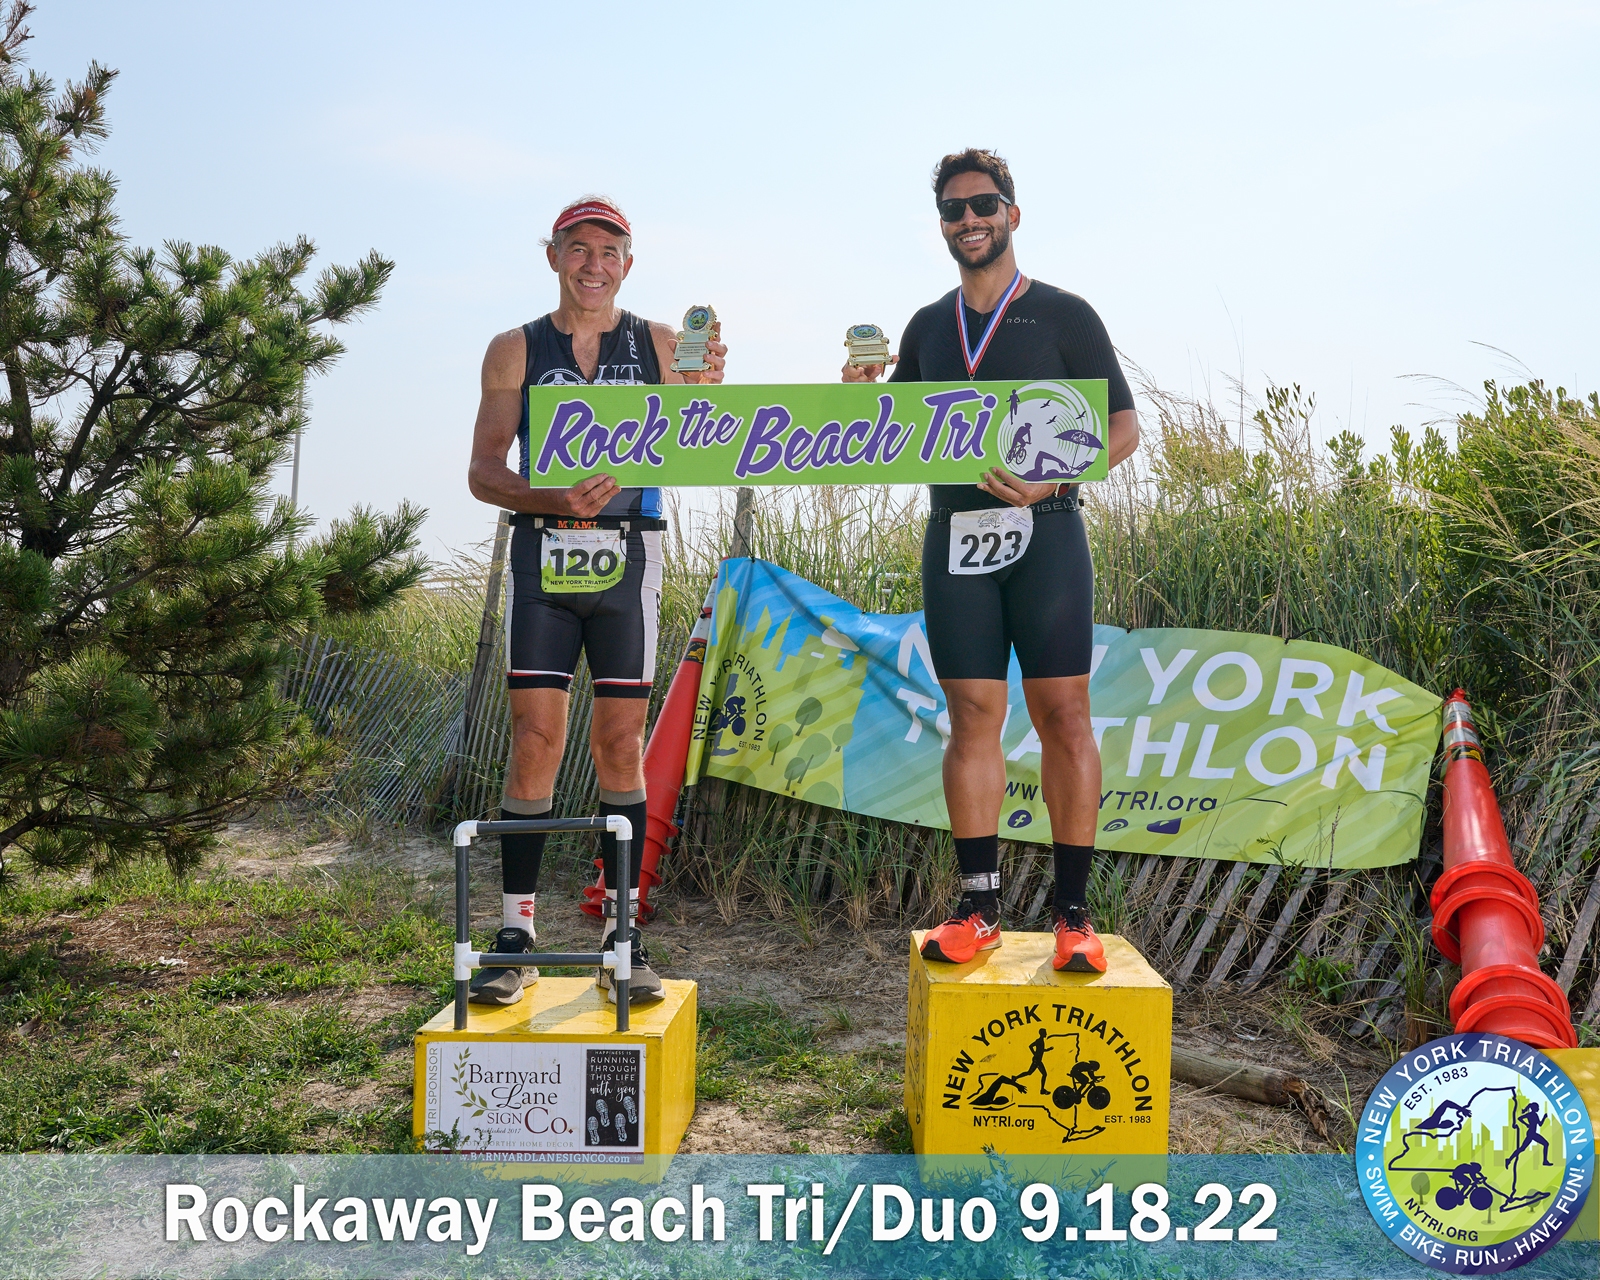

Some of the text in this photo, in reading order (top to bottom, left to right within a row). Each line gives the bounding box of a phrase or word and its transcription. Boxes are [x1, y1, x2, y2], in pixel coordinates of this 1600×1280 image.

[535, 394, 670, 475] Rock
[677, 398, 744, 449] the
[734, 394, 916, 479] Beach
[919, 388, 998, 463] Tri
[550, 548, 618, 577] 120
[960, 530, 1023, 568] 223
[584, 576, 617, 586] TRIATHLON
[693, 694, 712, 740] NEW
[734, 651, 767, 742] RIATHLON
[1140, 647, 1405, 737] YORK
[738, 740, 748, 748] EST.
[942, 1050, 975, 1109] NEW
[972, 1004, 1042, 1047] YORK
[1052, 1004, 1153, 1111] TRIATHLON
[428, 1047, 438, 1134] YTRI SPONSOR
[468, 1063, 561, 1092] Barnyard
[589, 1080, 637, 1103] with you
[491, 1084, 558, 1109] Lane
[487, 1107, 574, 1135] SIGN Co.
[973, 1115, 1035, 1131] NYTRI.org
[1104, 1115, 1152, 1124] EST. 1983
[519, 1140, 543, 1148] HOME
